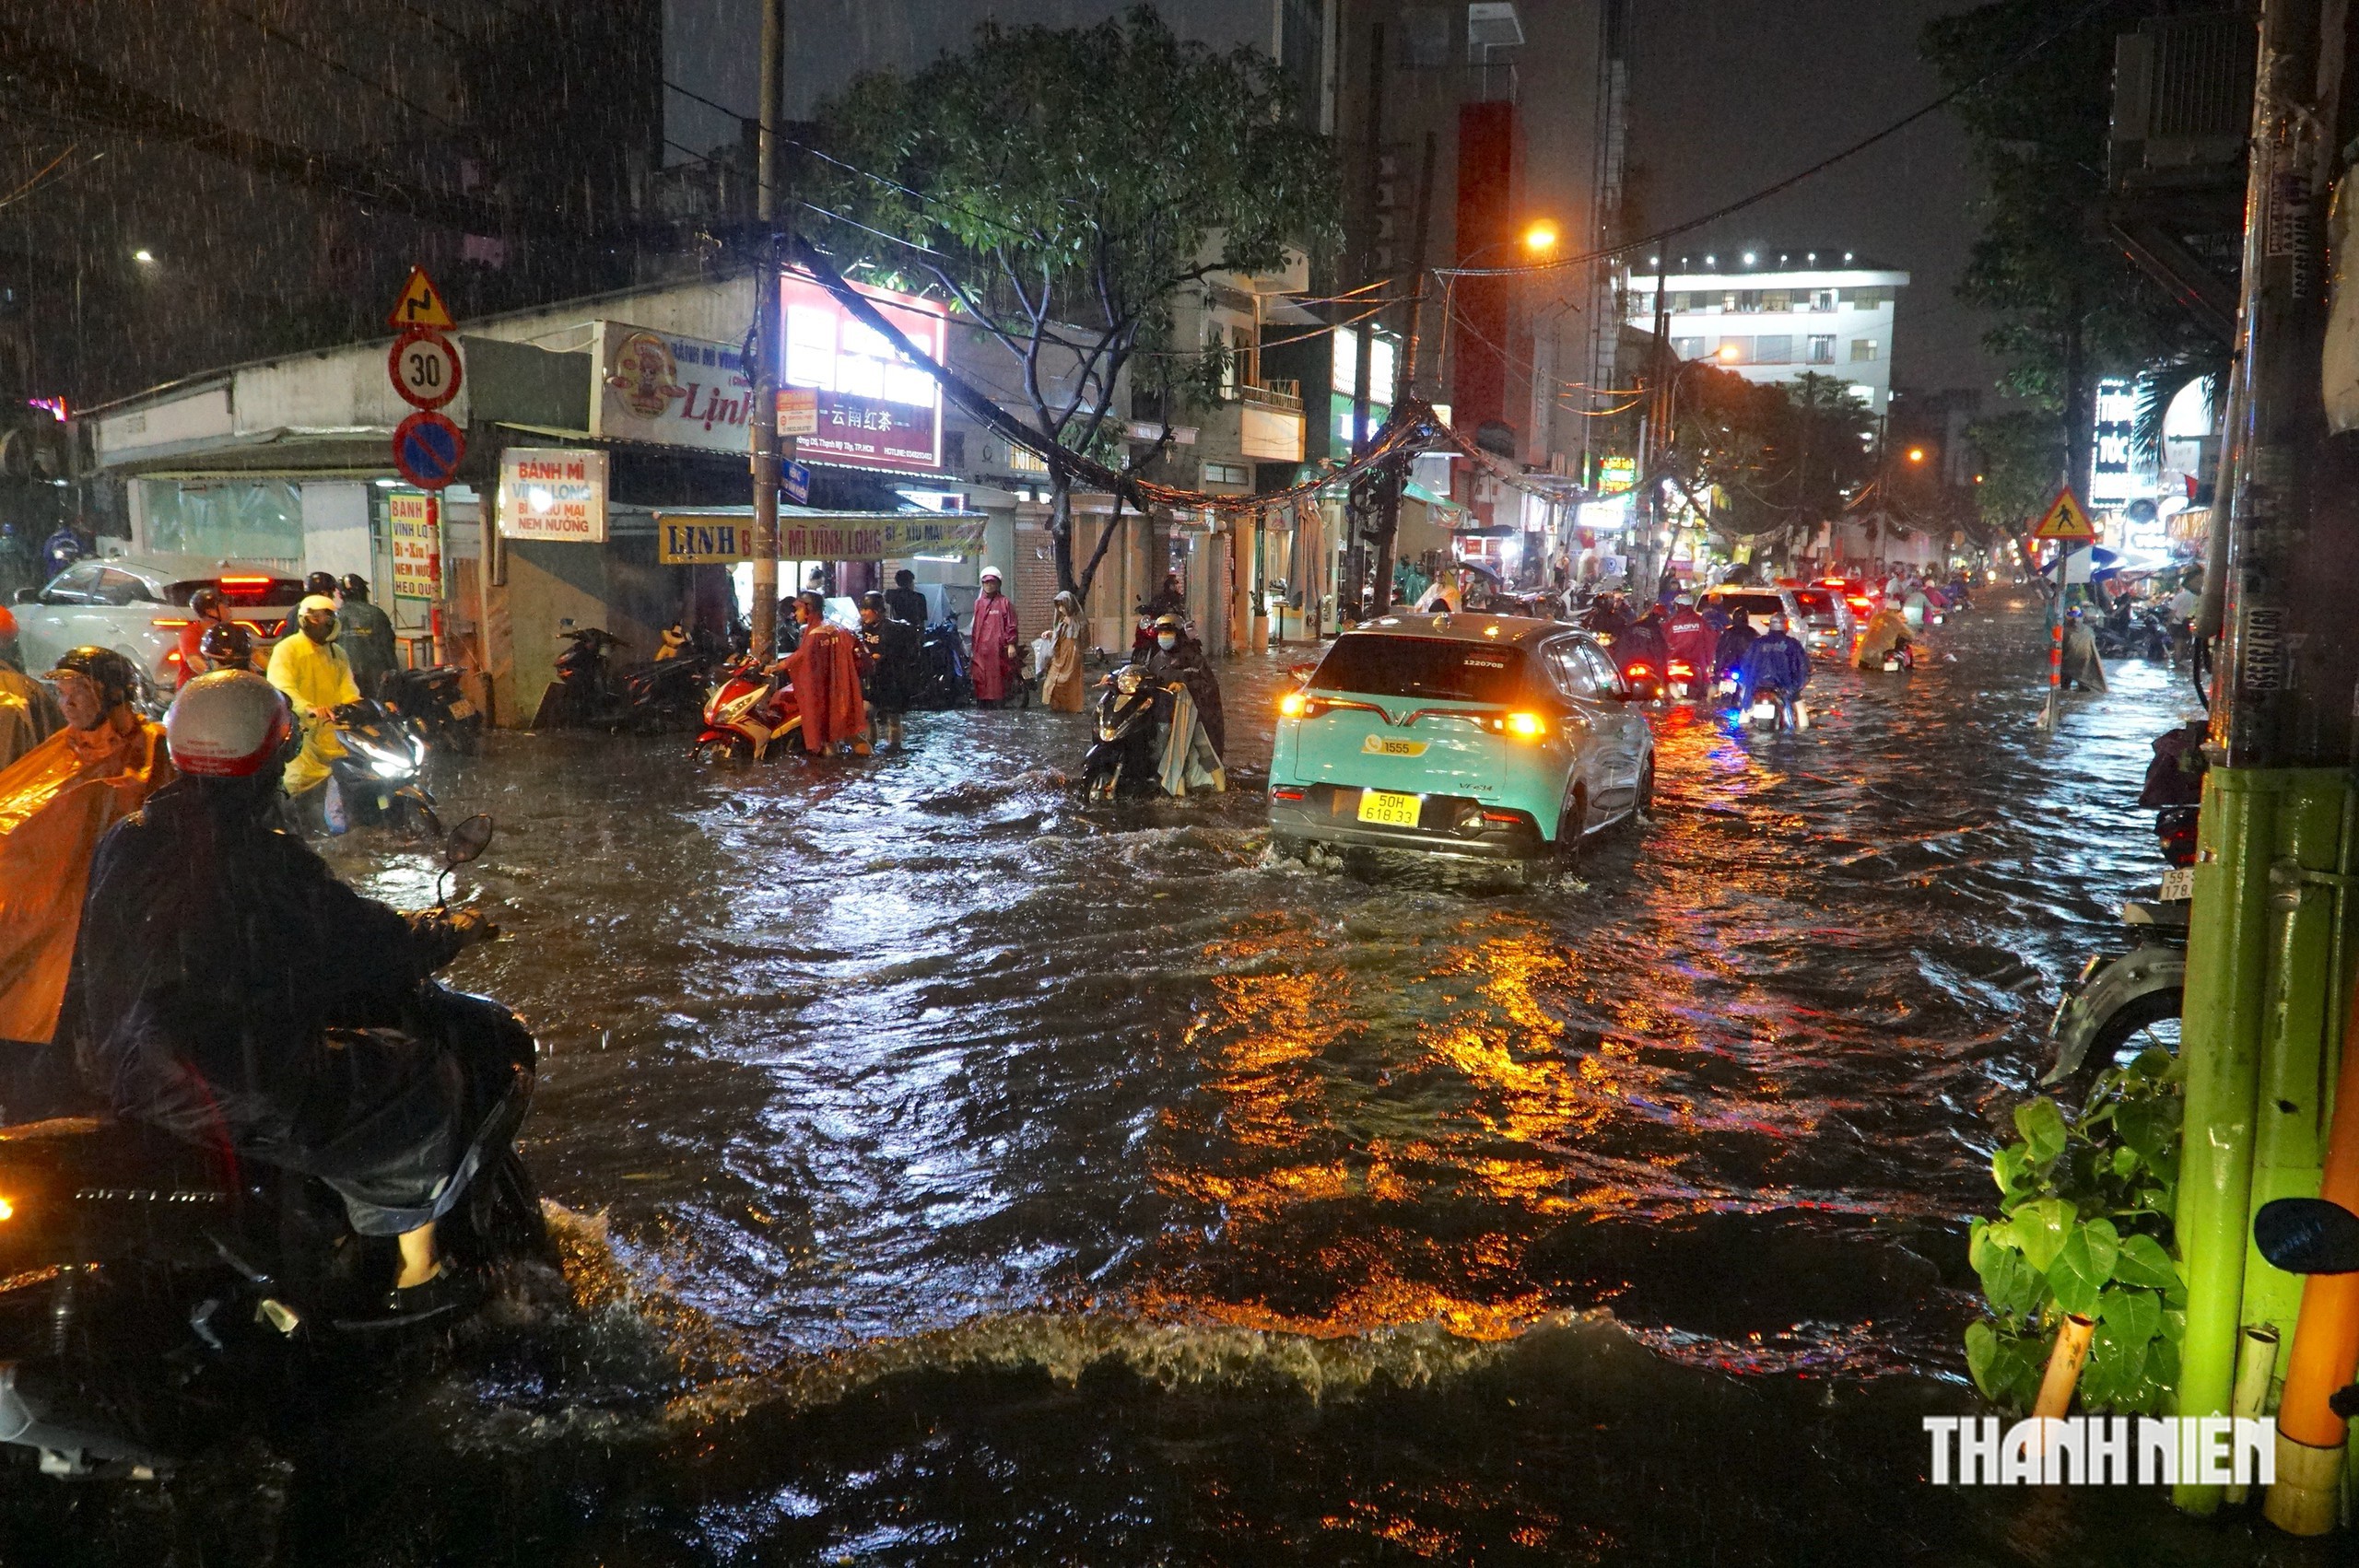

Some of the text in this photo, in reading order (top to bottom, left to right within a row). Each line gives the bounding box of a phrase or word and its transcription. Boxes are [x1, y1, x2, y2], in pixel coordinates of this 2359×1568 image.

[410, 354, 440, 386] 30
[831, 404, 893, 432] 云南红茶
[2099, 431, 2129, 463] TÓC
[518, 458, 584, 480] BÁNH MÌ
[512, 479, 592, 500] VĨN LONG
[392, 497, 422, 518] BÁNH
[519, 518, 542, 530] NEM
[668, 525, 735, 559] LỊNH
[811, 524, 843, 556] VĨNH
[848, 529, 881, 555] LONG
[394, 563, 413, 576] NEM
[396, 580, 415, 594] HEO
[1385, 742, 1409, 754] 1555
[1379, 795, 1404, 808] 50H
[1366, 807, 1413, 824] 618.33
